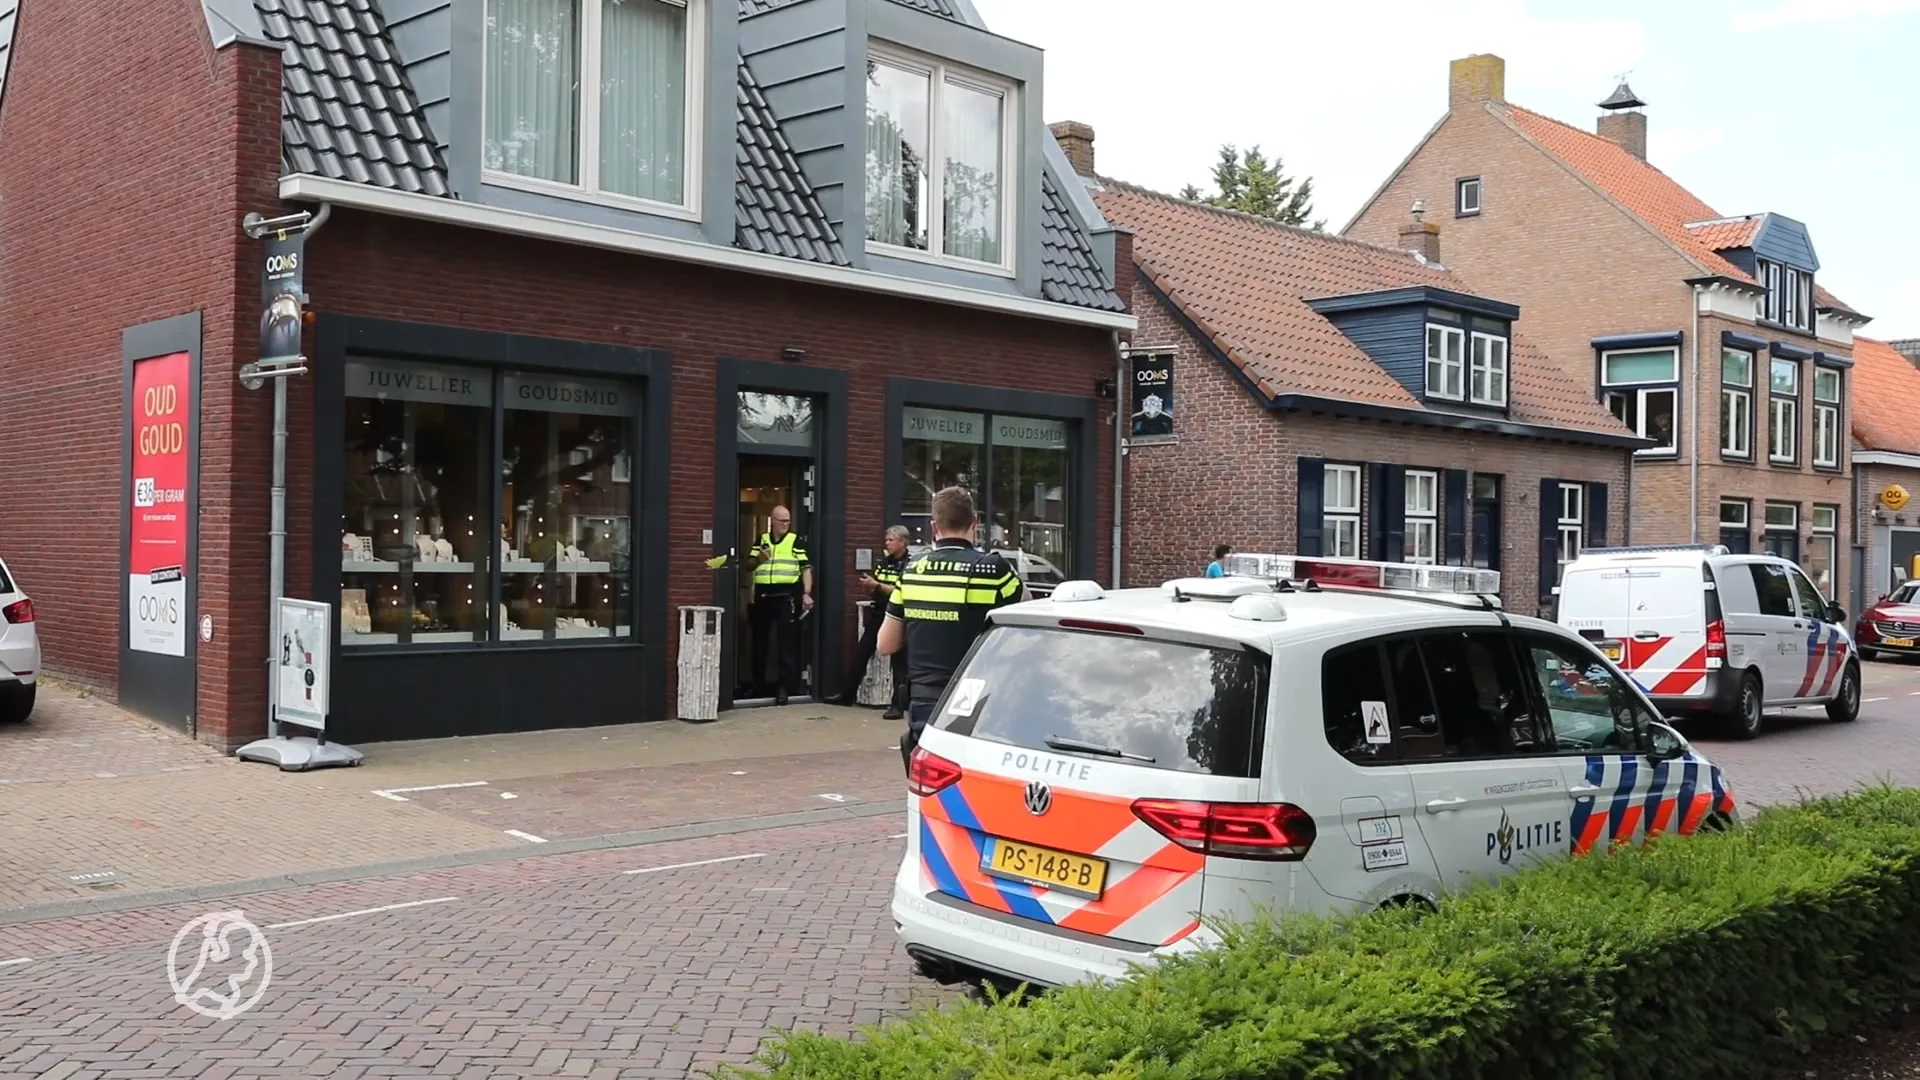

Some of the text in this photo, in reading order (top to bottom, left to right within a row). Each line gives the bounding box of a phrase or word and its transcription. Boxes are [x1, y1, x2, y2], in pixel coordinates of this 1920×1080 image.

[266, 252, 297, 272] OOMS
[368, 370, 618, 406] JUWELIER GOUDSMID
[1137, 369, 1168, 381] OOMS
[144, 384, 176, 417] OUD
[140, 423, 182, 455] GOUD
[911, 417, 1062, 441] JUWELIER GOUDSMID
[165, 489, 184, 503] GRAM
[139, 595, 178, 625] OOMS
[1001, 752, 1092, 781] POLITIE
[1374, 822, 1387, 833] 112
[1487, 820, 1562, 863] POLITIE
[1001, 845, 1093, 886] PS-148-B
